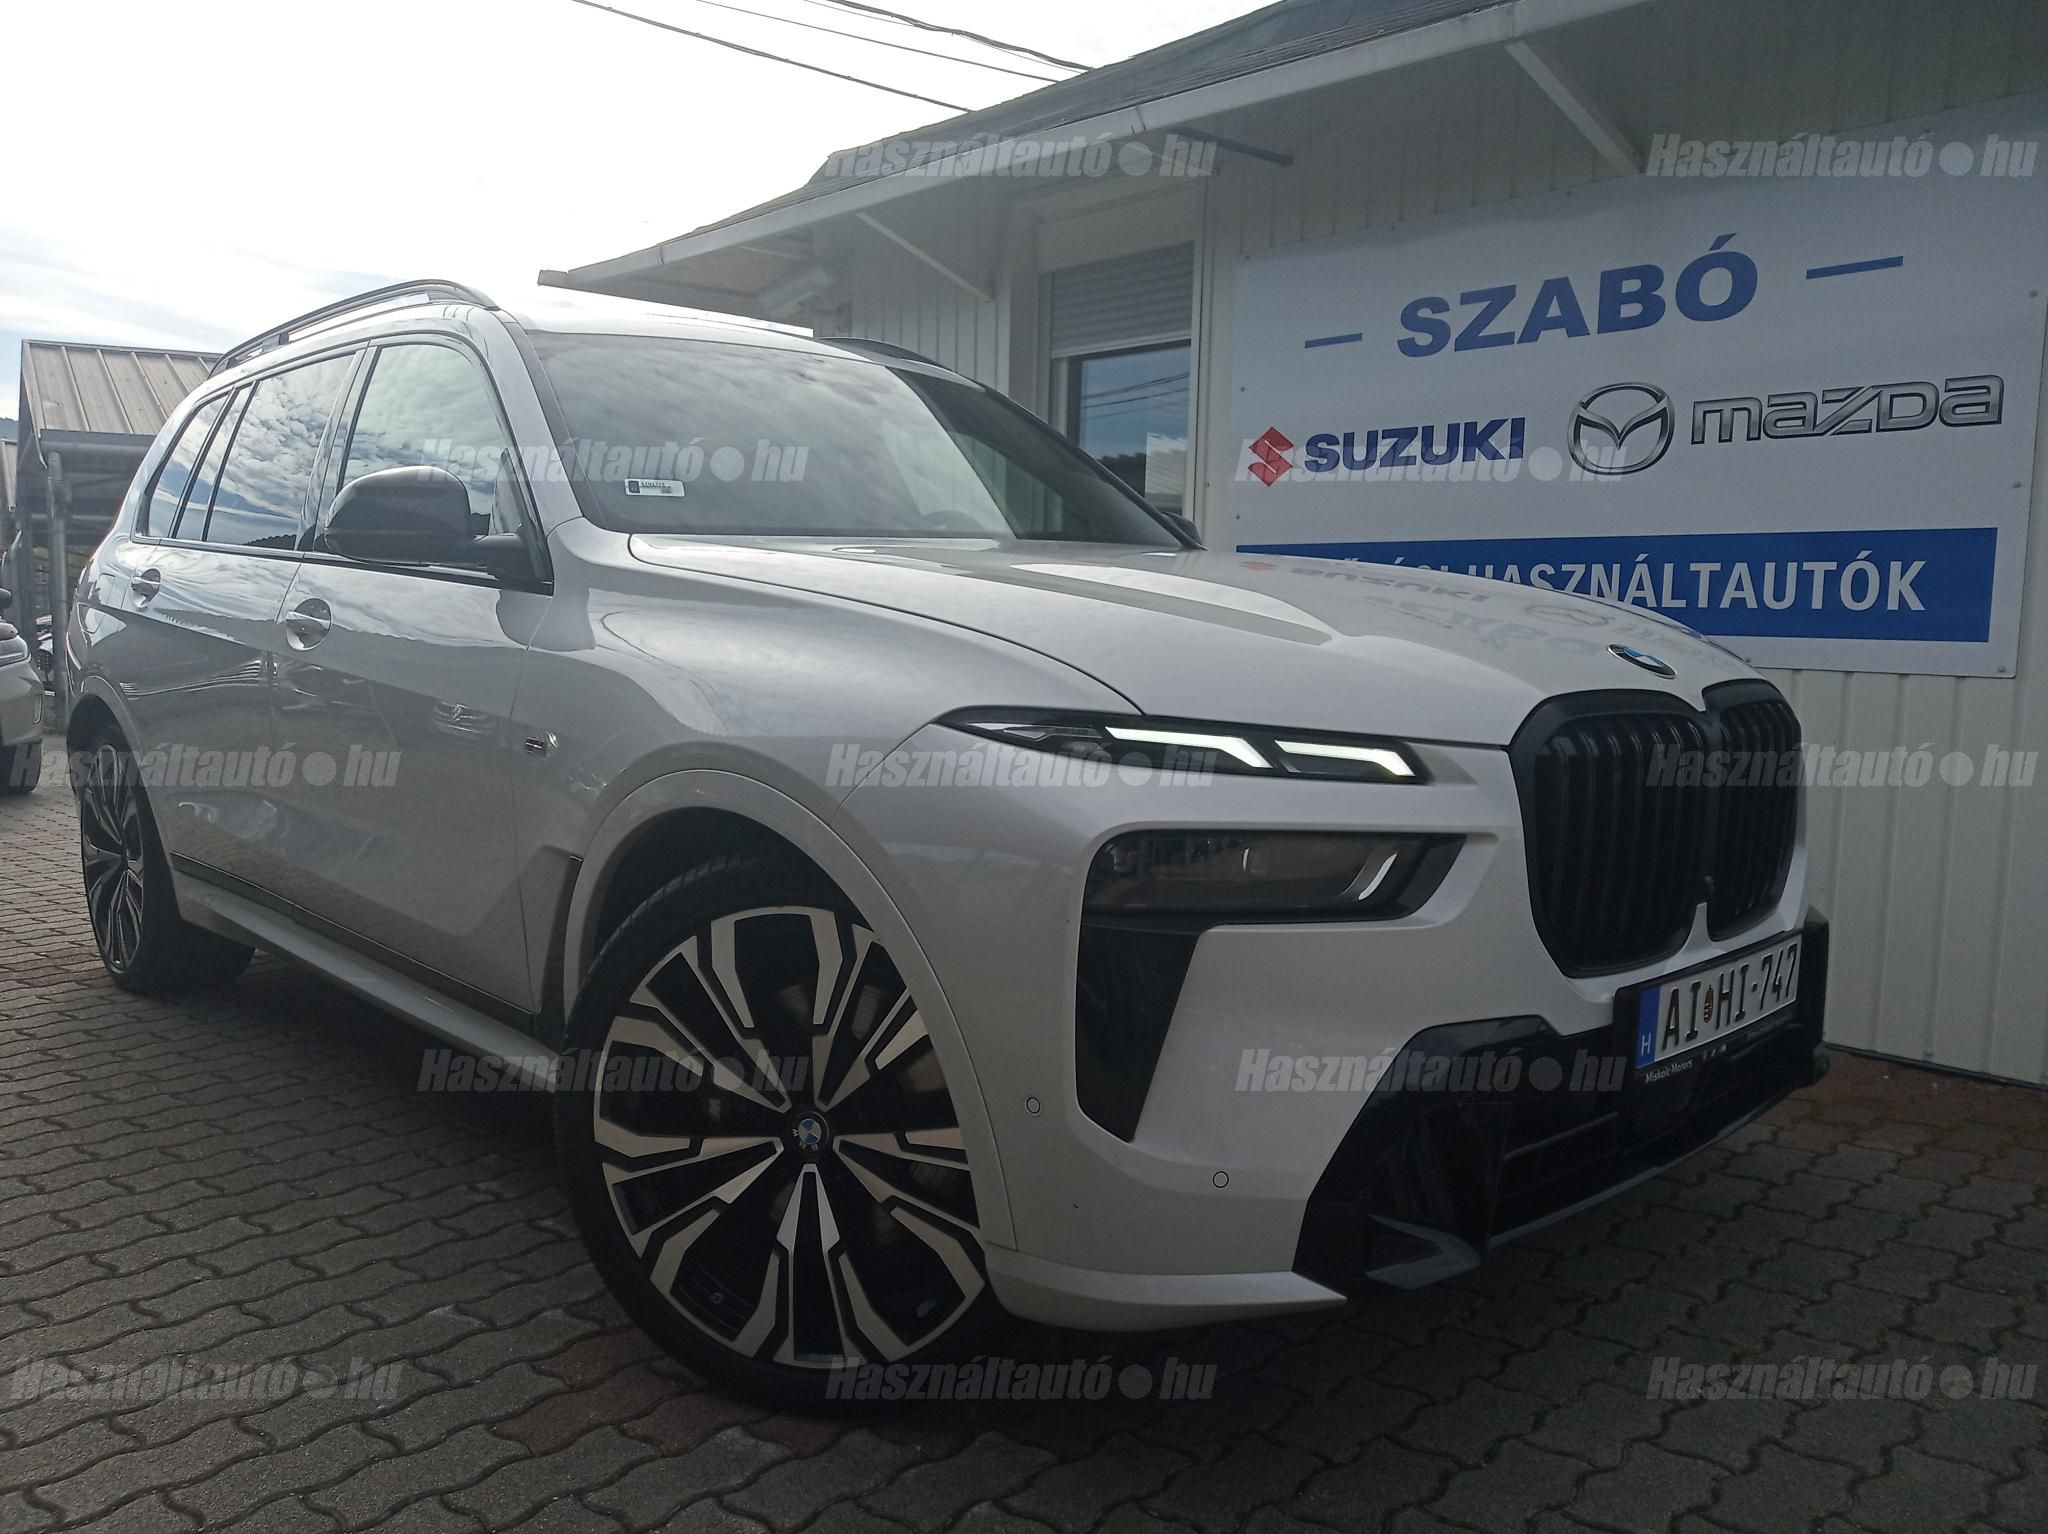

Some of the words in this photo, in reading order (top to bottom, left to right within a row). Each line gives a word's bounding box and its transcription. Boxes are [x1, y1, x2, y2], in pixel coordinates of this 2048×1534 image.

[1397, 233, 1758, 357] SZABÓ
[1304, 417, 1525, 473] SUZUKI
[1468, 550, 1926, 611] SZNÁLTAUTÓK
[1641, 1032, 1651, 1056] H
[1671, 1058, 1694, 1075] Motors
